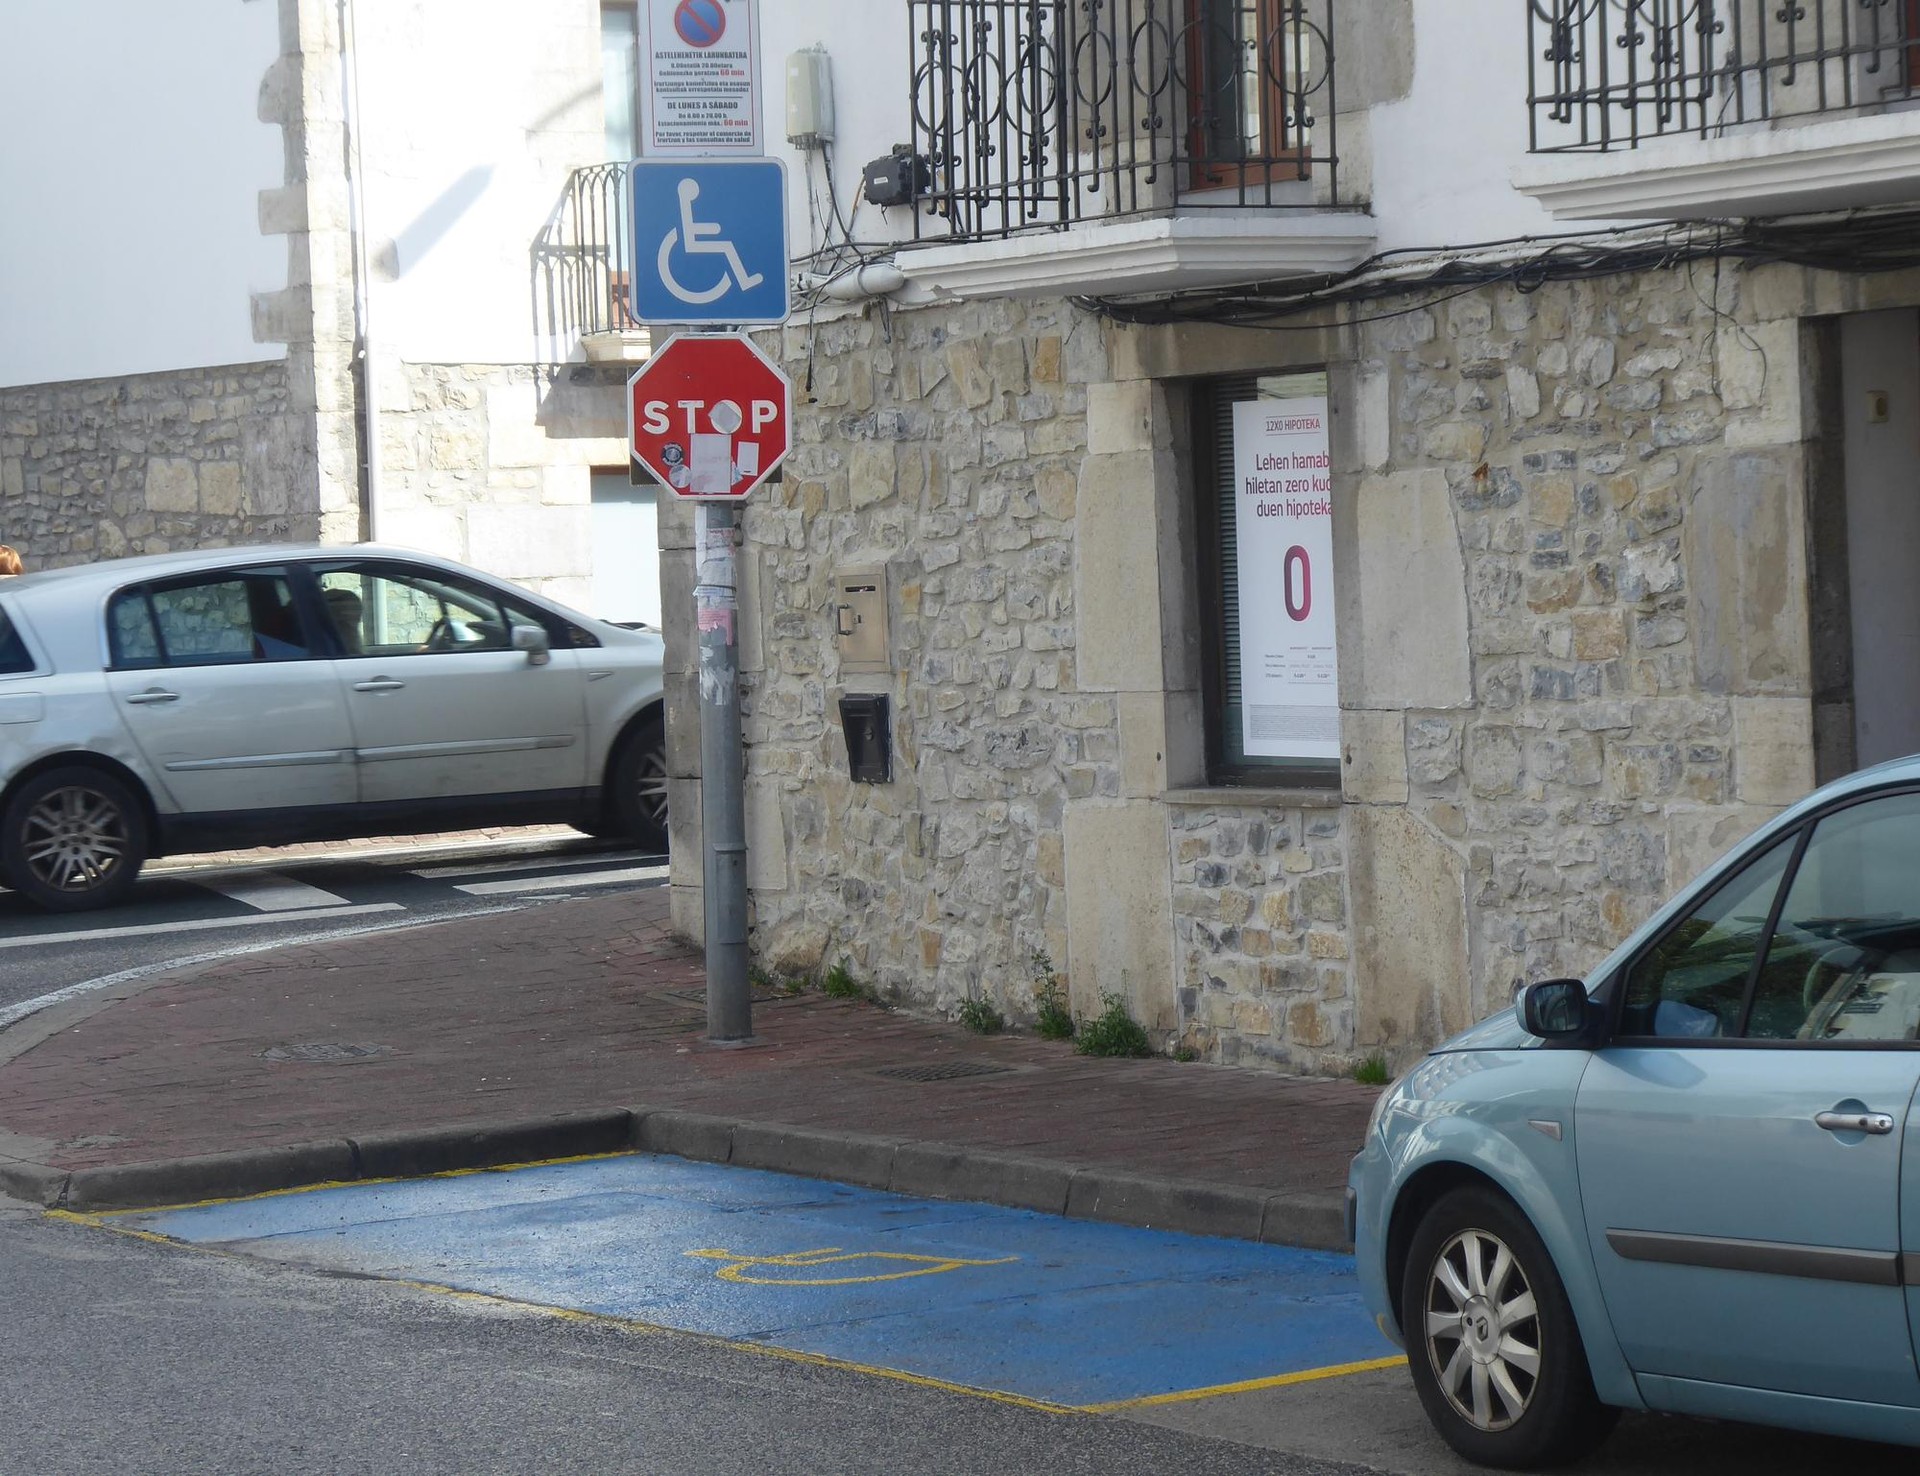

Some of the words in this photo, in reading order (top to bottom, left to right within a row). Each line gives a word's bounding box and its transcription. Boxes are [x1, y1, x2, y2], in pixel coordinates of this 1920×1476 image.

[642, 400, 778, 435] STOP
[1284, 418, 1321, 430] HIPOTEKA
[1256, 453, 1289, 471] Lehen
[1292, 450, 1330, 469] hamab
[1245, 476, 1282, 494] hiletan
[1285, 478, 1309, 493] zero
[1312, 474, 1332, 492] kuo
[1257, 500, 1283, 517] duen
[1286, 497, 1332, 520] hipoteka
[1284, 545, 1312, 622] 0
